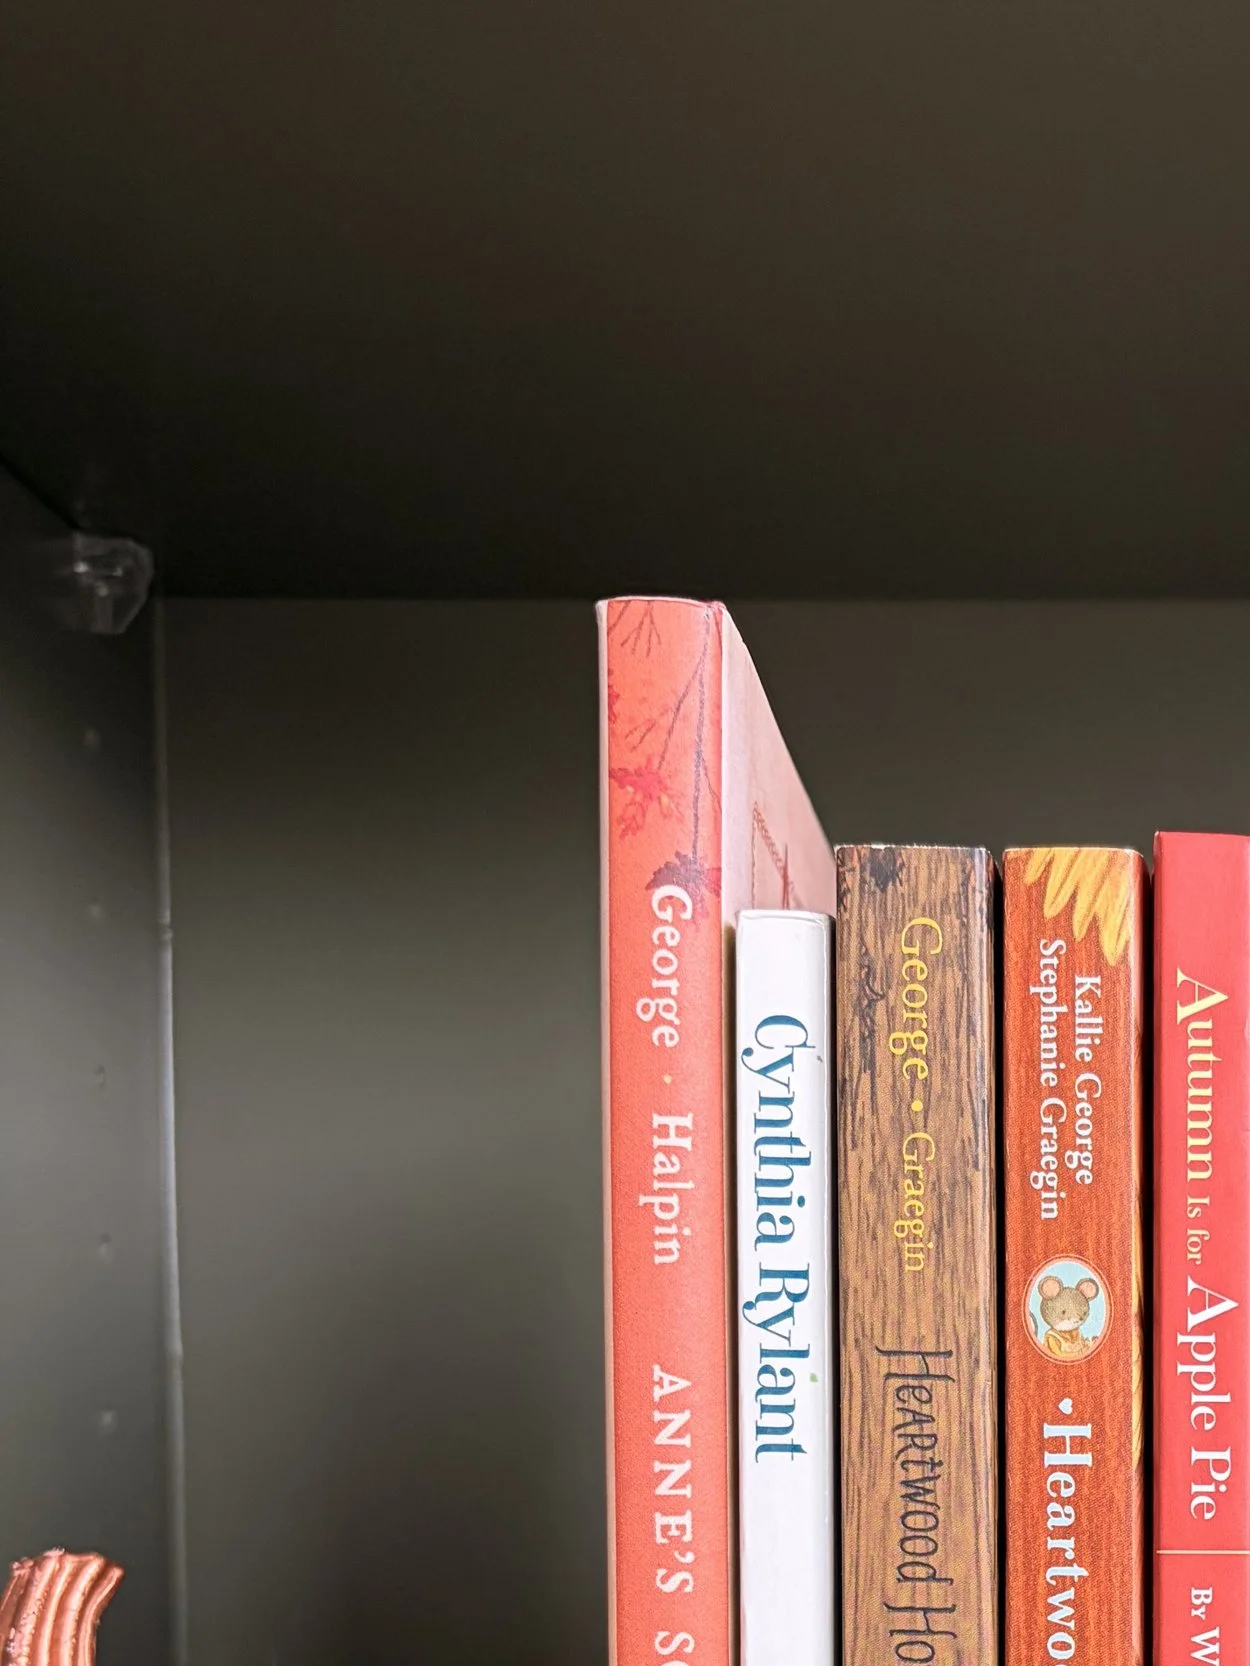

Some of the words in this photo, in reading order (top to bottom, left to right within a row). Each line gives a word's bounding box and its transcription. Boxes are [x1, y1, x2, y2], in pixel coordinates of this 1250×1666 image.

[636, 884, 692, 1048] George
[890, 917, 942, 1080] George
[1032, 939, 1065, 1086] Stephanie
[1074, 975, 1102, 1062] Kallie
[742, 1014, 816, 1251] Cynthia
[1065, 1073, 1101, 1184] George
[1177, 967, 1228, 1181] Autumn
[639, 1112, 693, 1266] Halpin
[894, 1132, 935, 1272] Graegin
[1030, 1097, 1064, 1219] Graegin
[1186, 1196, 1210, 1219] Is
[1186, 1229, 1211, 1264] for
[743, 1263, 810, 1462] Rylant
[1176, 1276, 1239, 1430] Apple
[651, 1364, 694, 1593] ANNE'S
[1189, 1447, 1232, 1520] Pie
